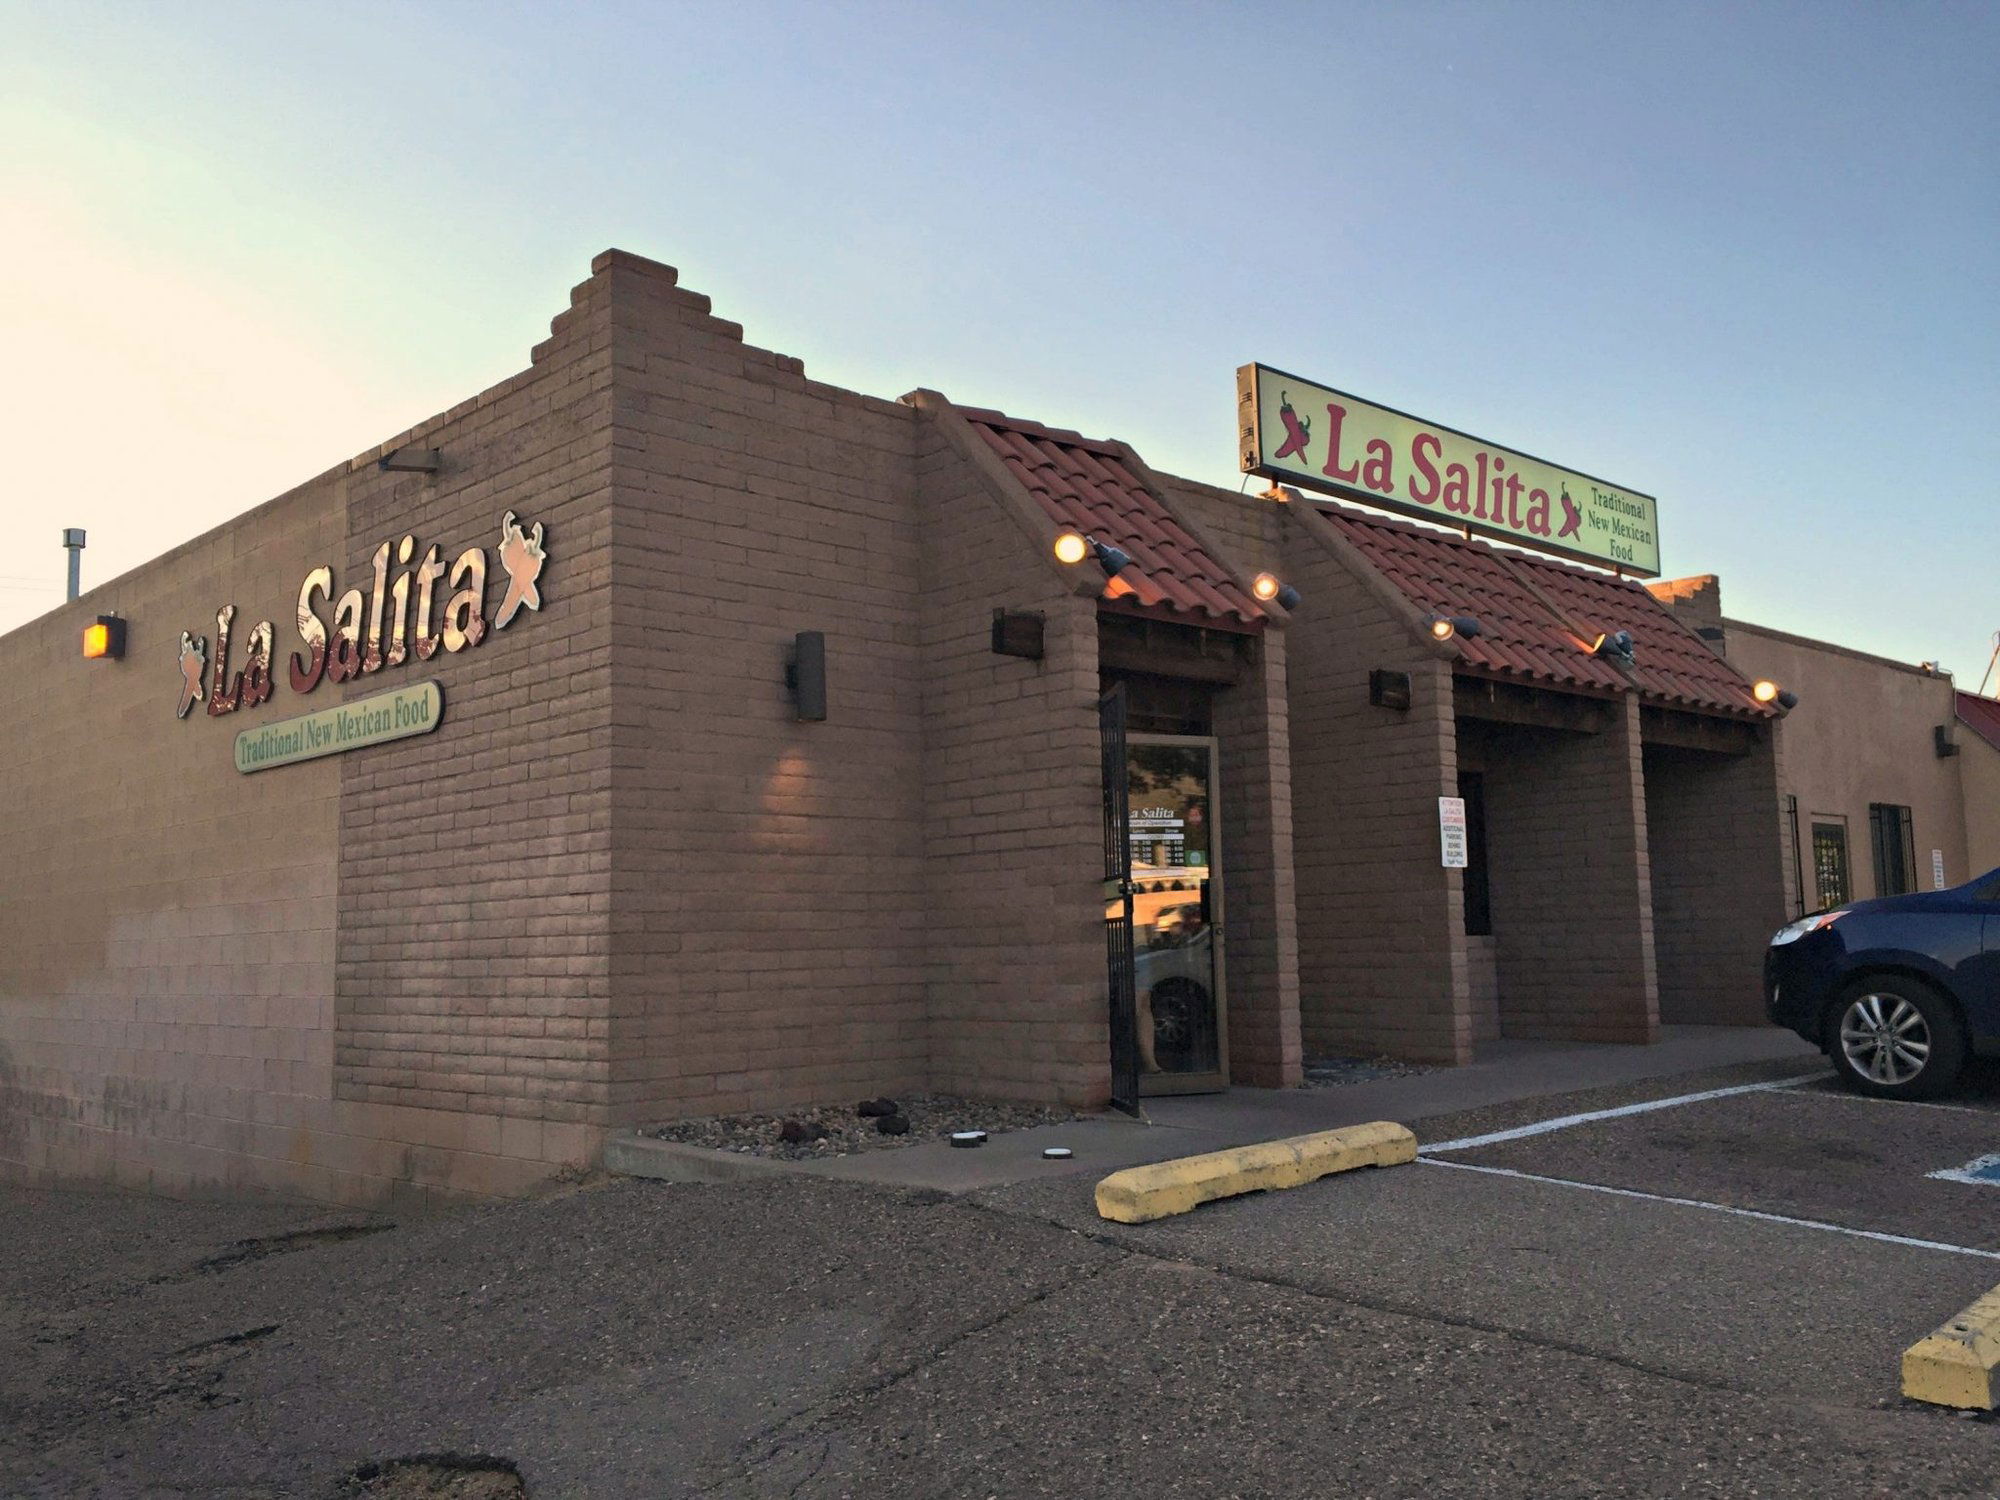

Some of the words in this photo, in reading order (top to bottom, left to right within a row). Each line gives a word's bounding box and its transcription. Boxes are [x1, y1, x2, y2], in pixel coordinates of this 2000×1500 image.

[1322, 403, 1395, 494] La
[1409, 432, 1552, 537] Salita
[1591, 487, 1646, 520] Traditional
[1588, 509, 1610, 531] New
[1612, 517, 1652, 545] Mexican
[1609, 538, 1633, 561] Food
[207, 604, 275, 717] La
[289, 534, 488, 694] Salita
[240, 724, 304, 765] Traditional
[307, 718, 335, 750] New
[335, 705, 391, 743] Mexican
[394, 688, 430, 729] Food
[1141, 807, 1175, 819] Salita
